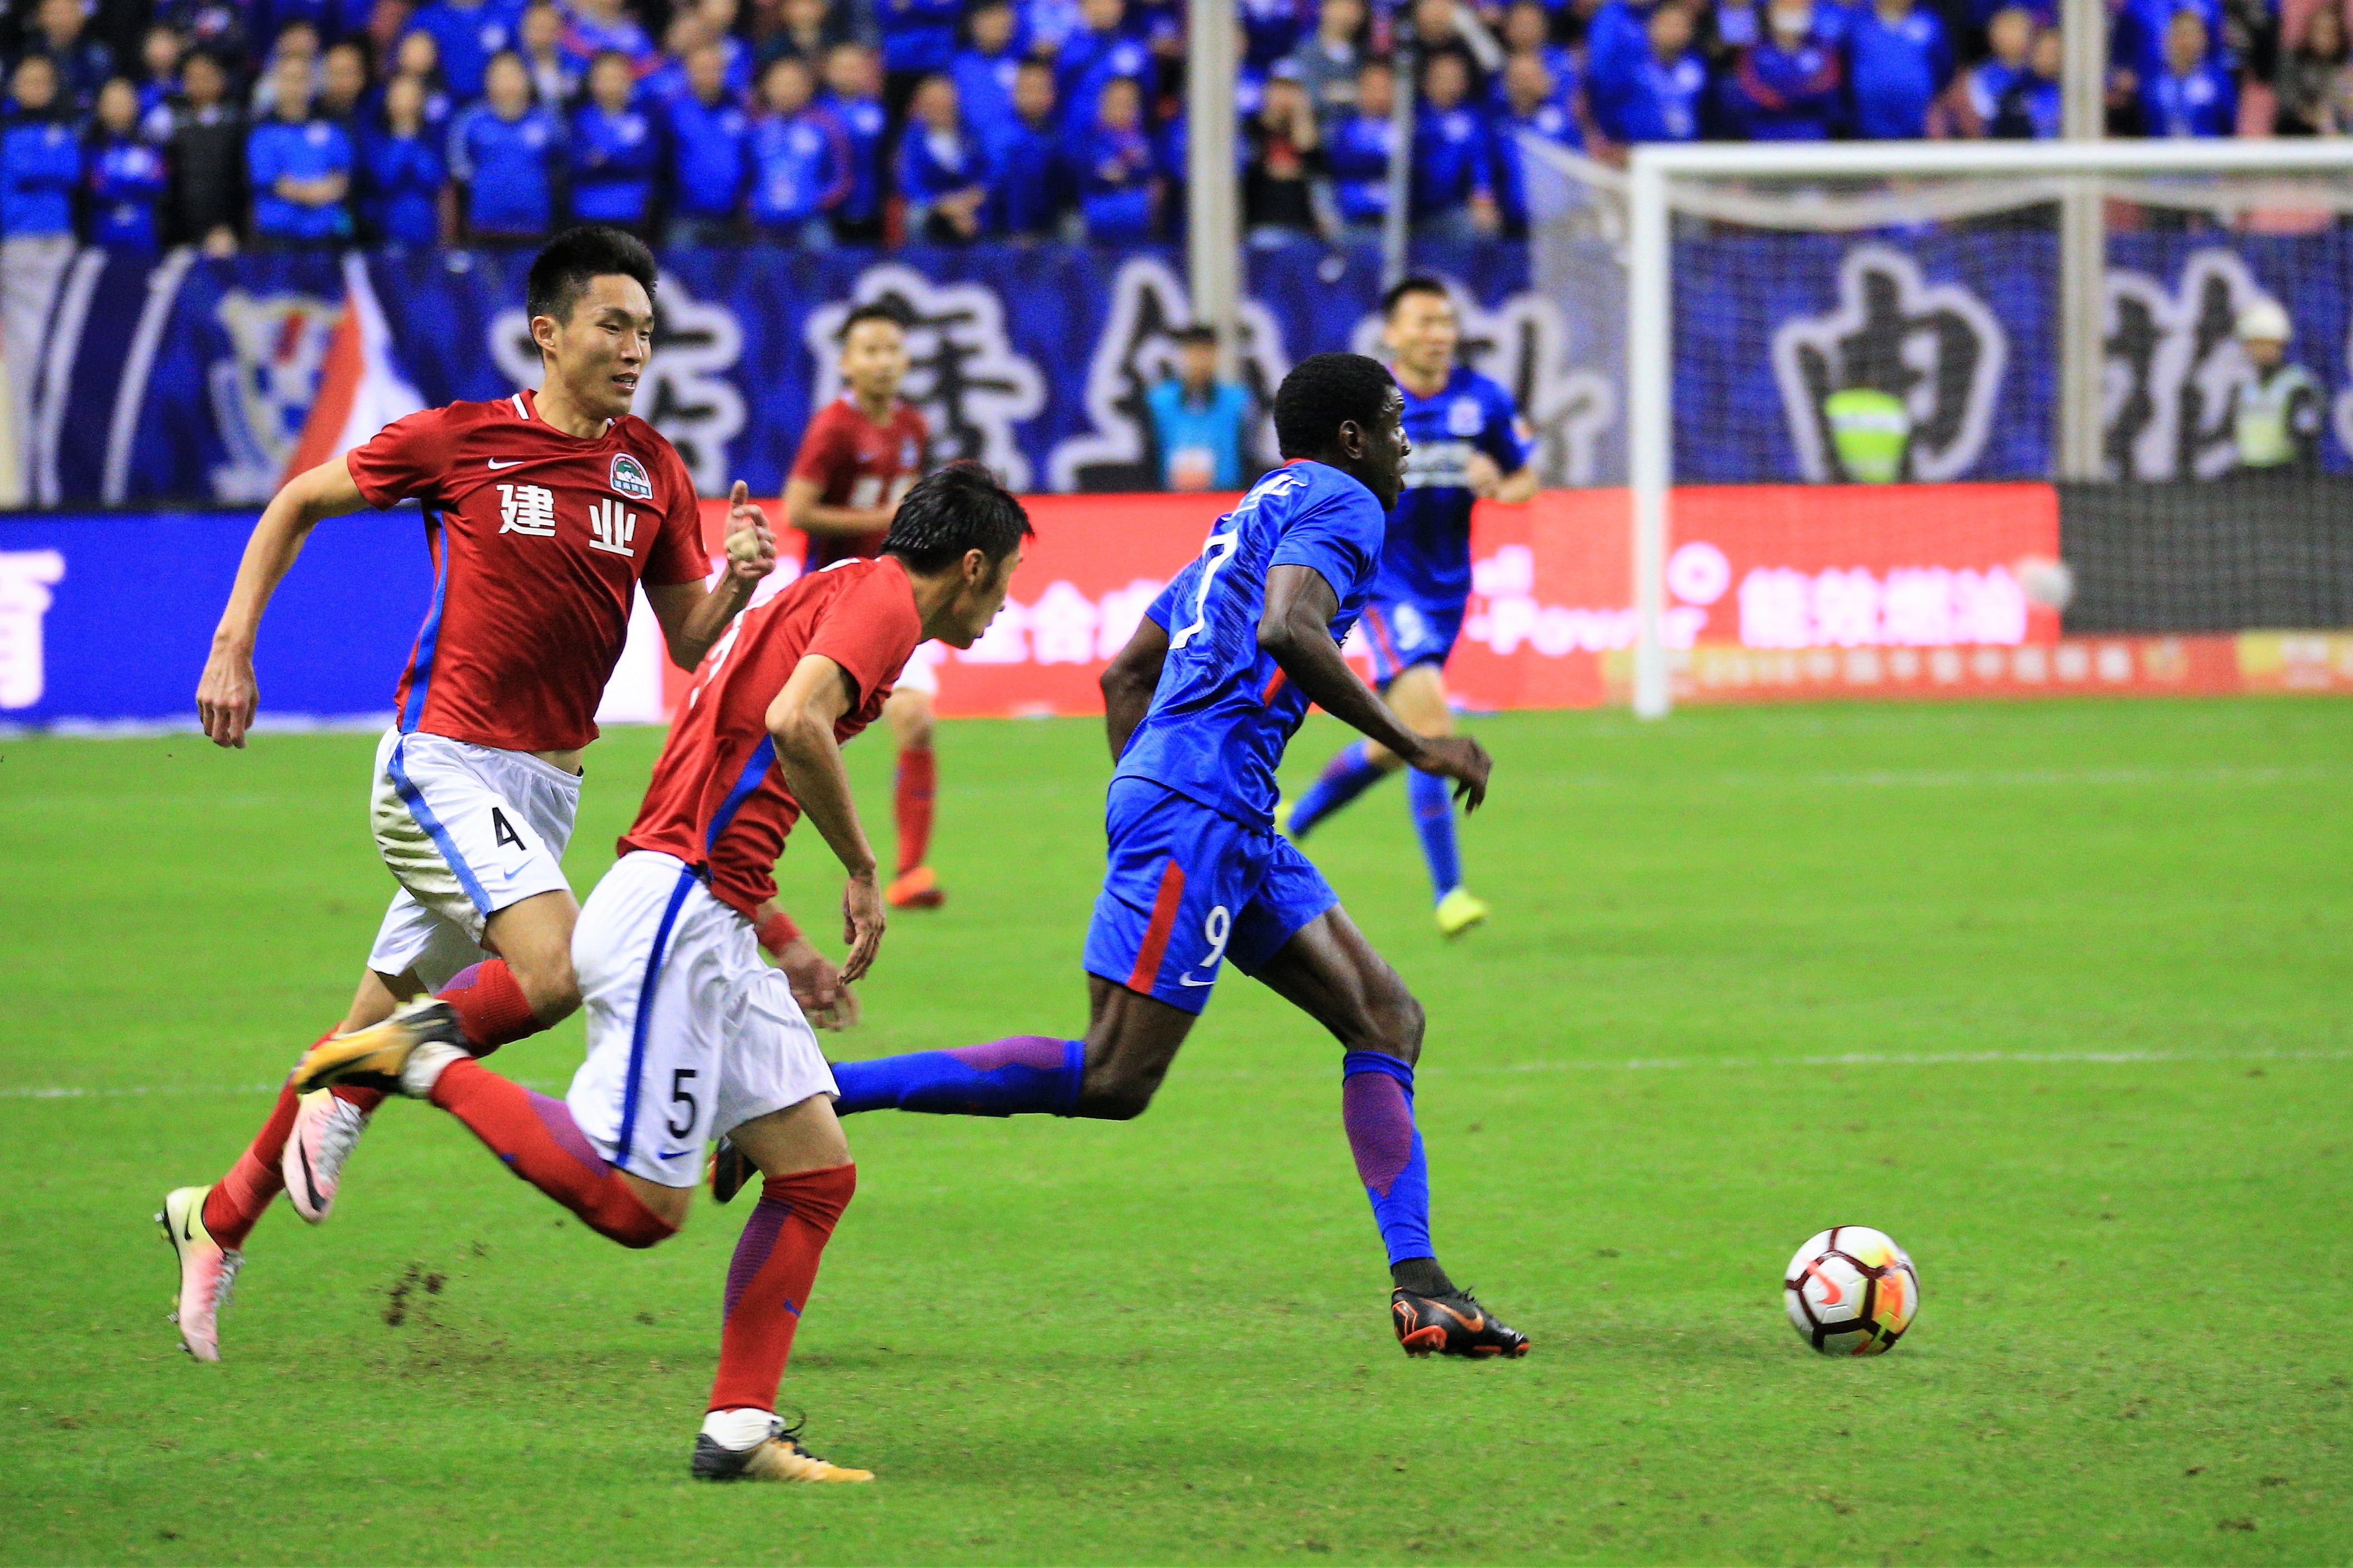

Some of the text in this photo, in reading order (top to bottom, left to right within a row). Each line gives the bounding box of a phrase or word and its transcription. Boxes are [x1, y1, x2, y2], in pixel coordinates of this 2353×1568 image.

[496, 484, 637, 557] 建业
[491, 807, 526, 851] 4
[1199, 905, 1231, 968] 9
[667, 1068, 696, 1139] 5
